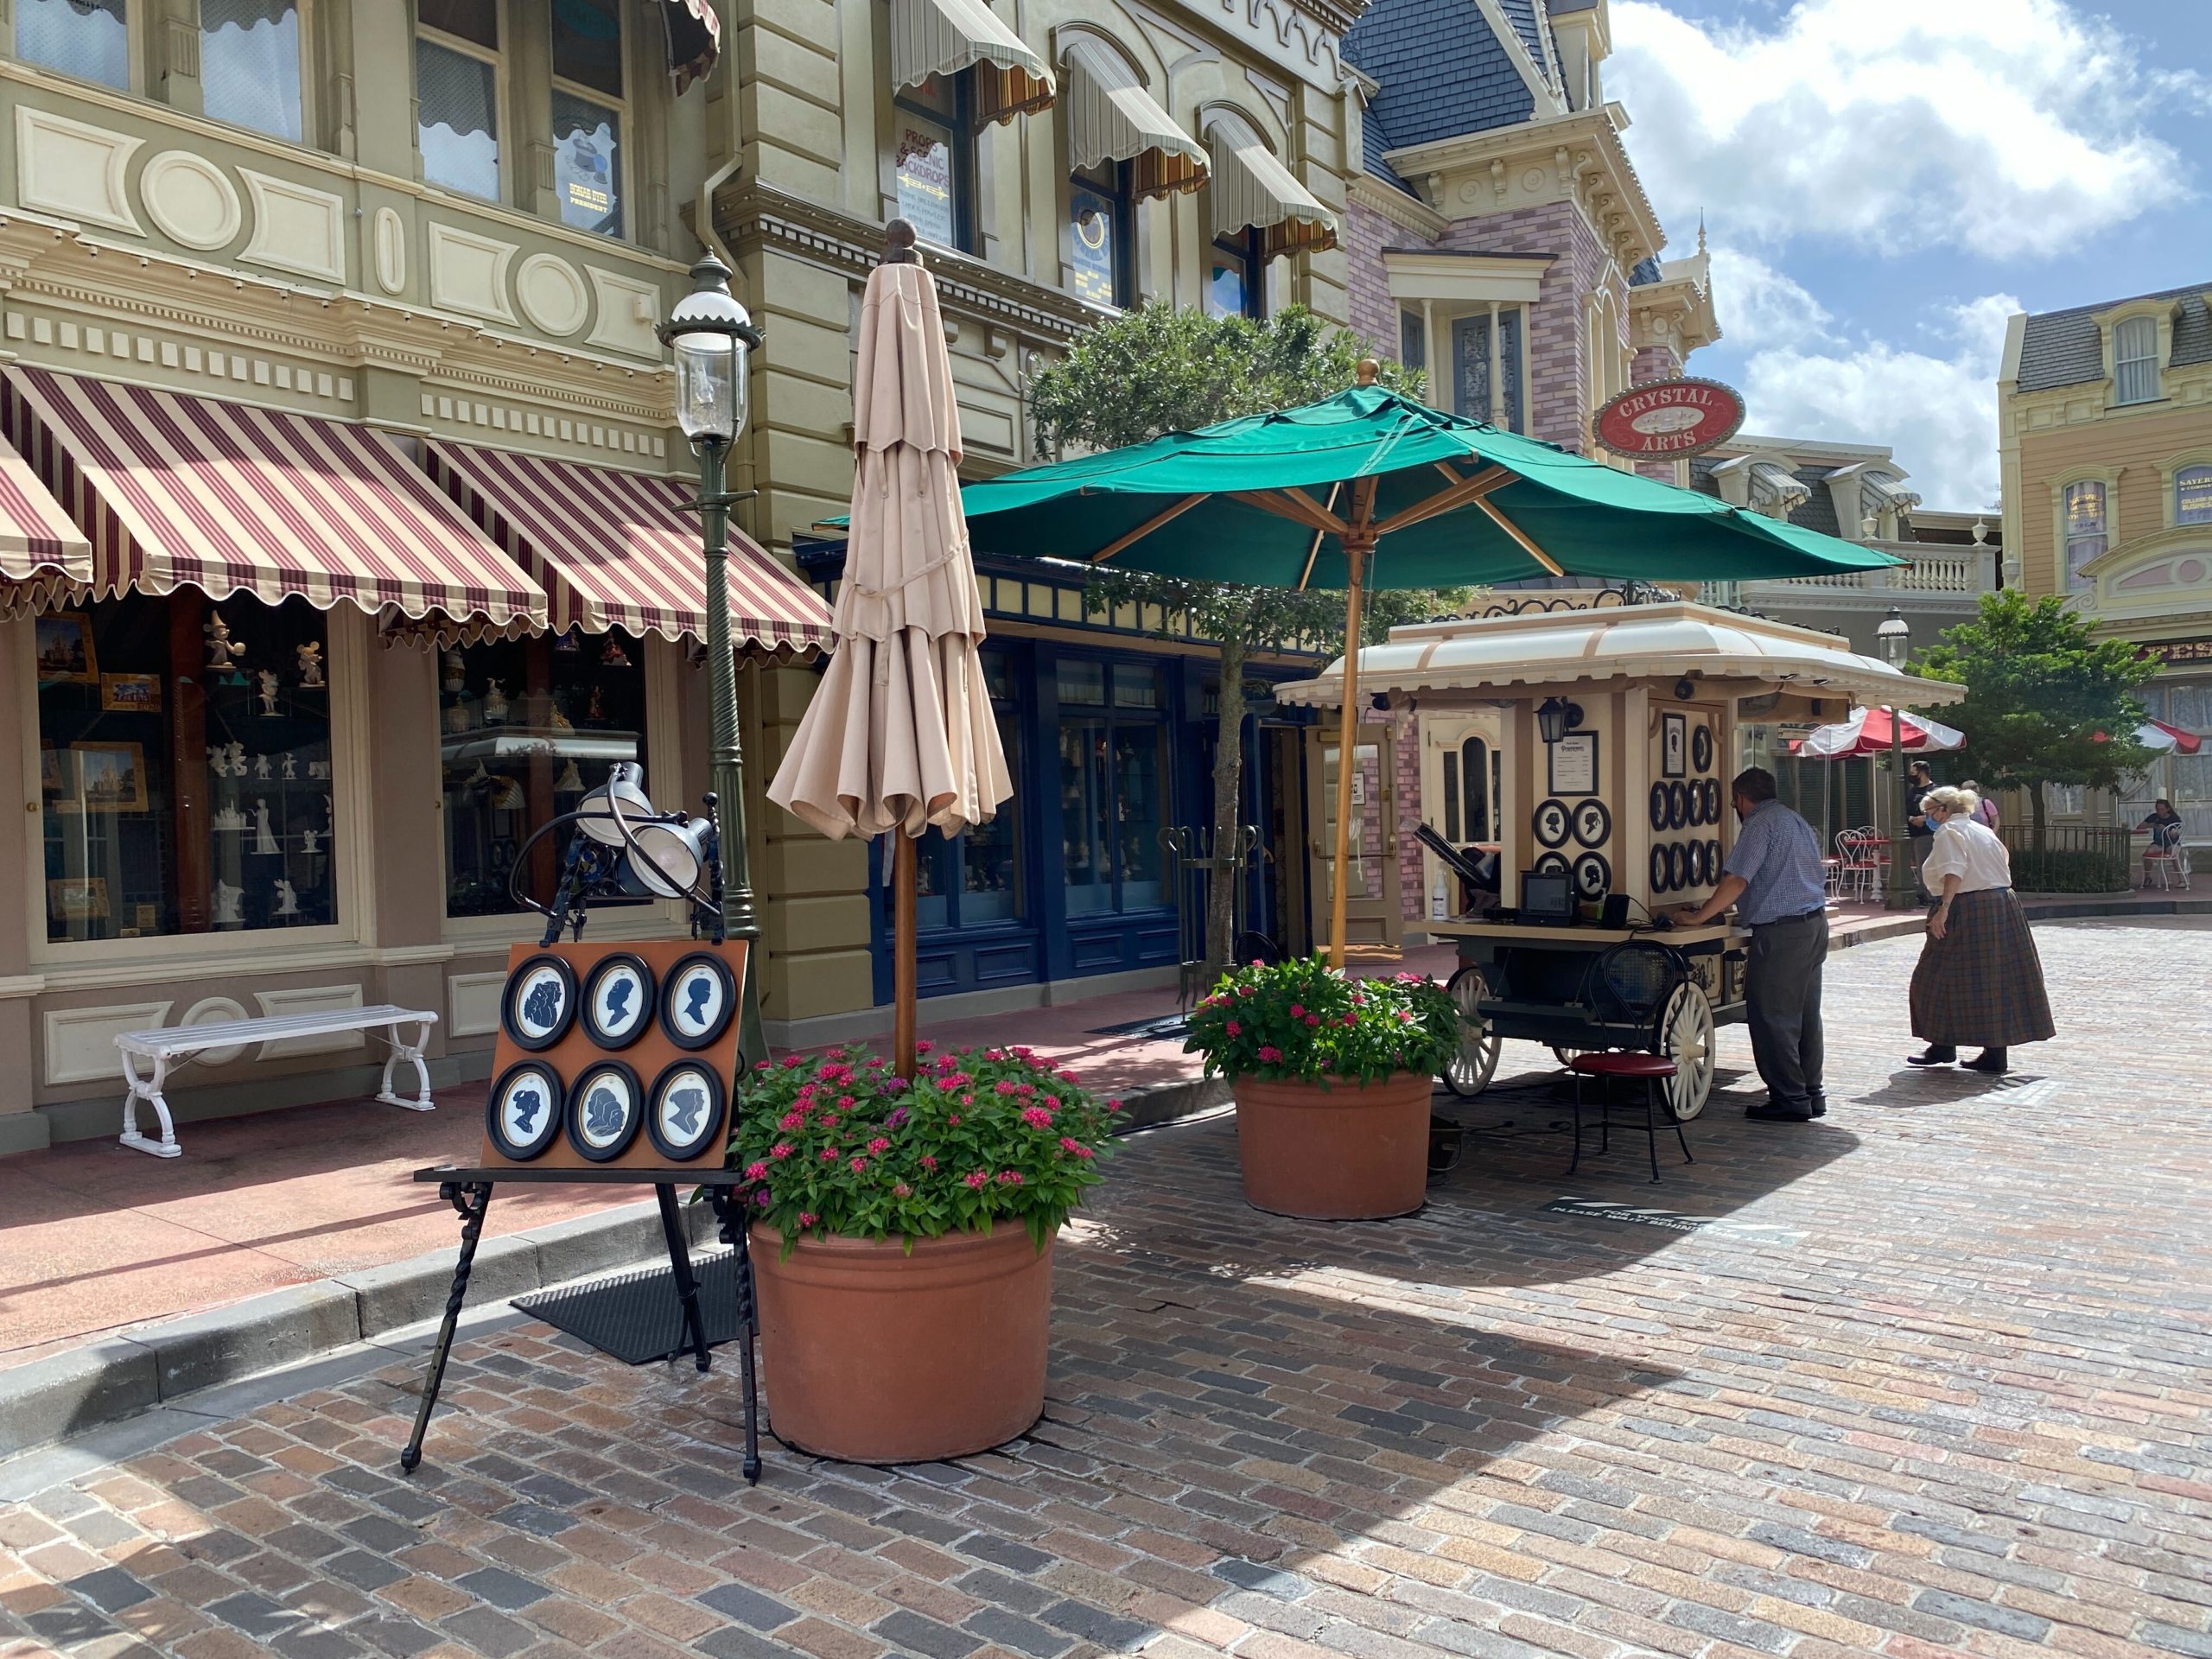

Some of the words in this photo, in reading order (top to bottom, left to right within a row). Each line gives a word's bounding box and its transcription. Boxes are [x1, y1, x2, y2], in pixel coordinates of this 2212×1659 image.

[906, 129, 938, 152] PROPS
[900, 142, 909, 156] &
[911, 146, 944, 170] SCENIC
[896, 155, 950, 188] BACKDROPS
[569, 196, 608, 213] PRESIDENT
[1619, 388, 1713, 417] CRYSTAL
[1642, 430, 1697, 451] ARTS
[1551, 1207, 1603, 1217] PLEASE
[1606, 1214, 1645, 1223] WAIT
[1647, 1220, 1702, 1231] BEHIND
[1637, 1214, 1675, 1223] YOUR
